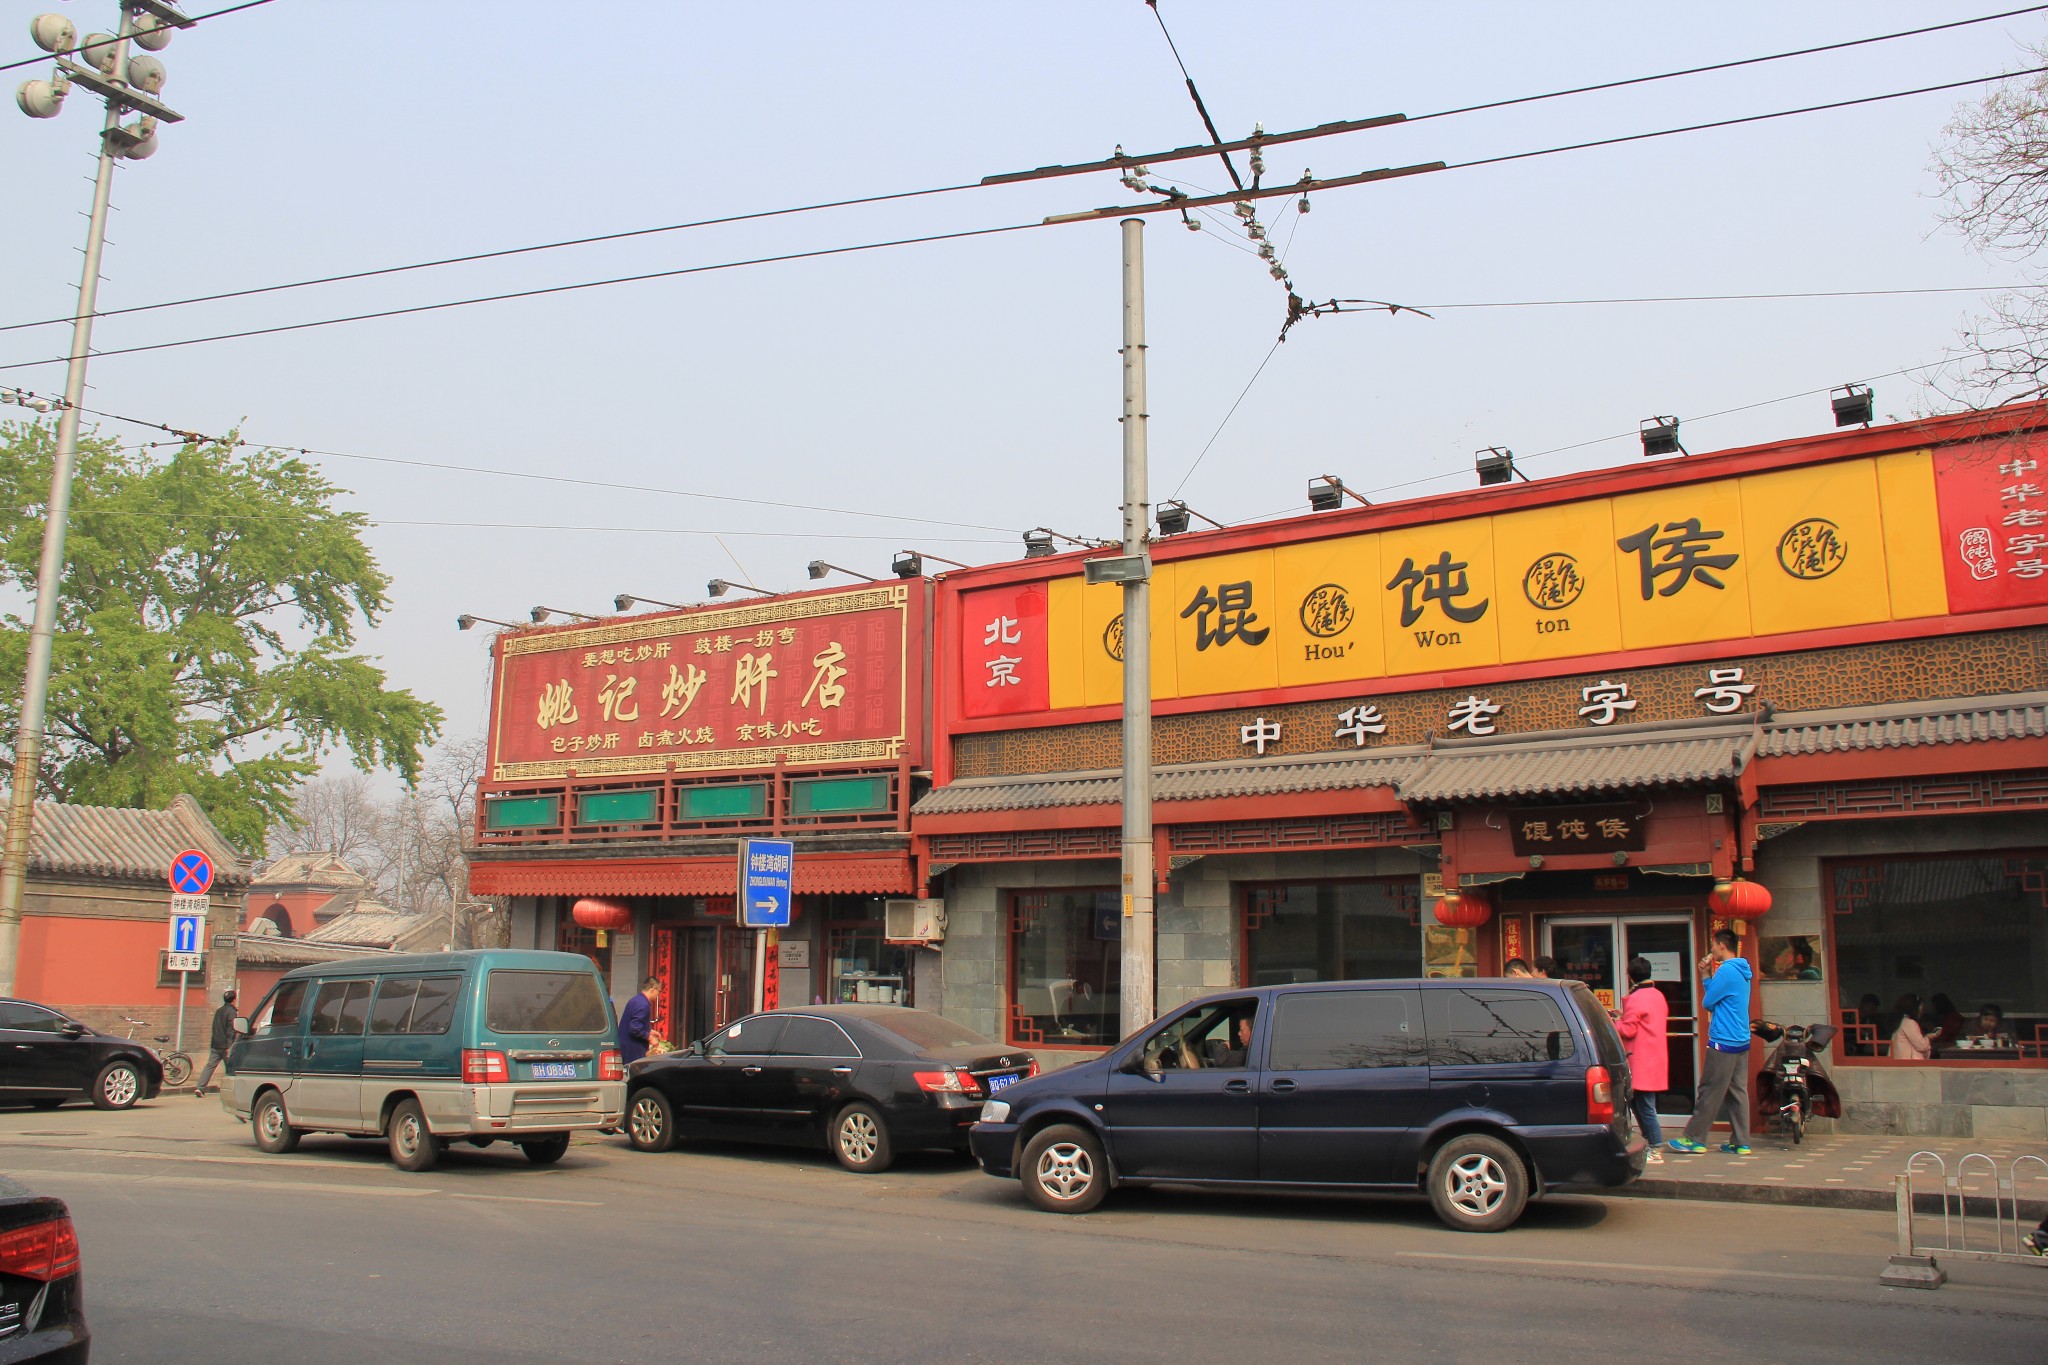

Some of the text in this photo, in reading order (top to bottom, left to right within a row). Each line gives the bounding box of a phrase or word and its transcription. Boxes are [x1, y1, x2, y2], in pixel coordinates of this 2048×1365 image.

[2000, 459, 2048, 578] 中华老字号
[581, 627, 797, 668] 要想吃炒肝 鼓楼一拐弯
[984, 615, 1022, 687] 北京
[1414, 630, 1462, 648] Won
[1536, 618, 1570, 634] ton
[537, 641, 847, 729] 姚记炒肝店
[1240, 667, 1756, 755] 中华老字号
[550, 717, 823, 753] 包子炒肝 卤煮火烧 京味小吃
[1521, 818, 1630, 842] 馄饨侯
[750, 853, 789, 873] 钟楼湾胡同
[169, 955, 200, 967] 机动车
